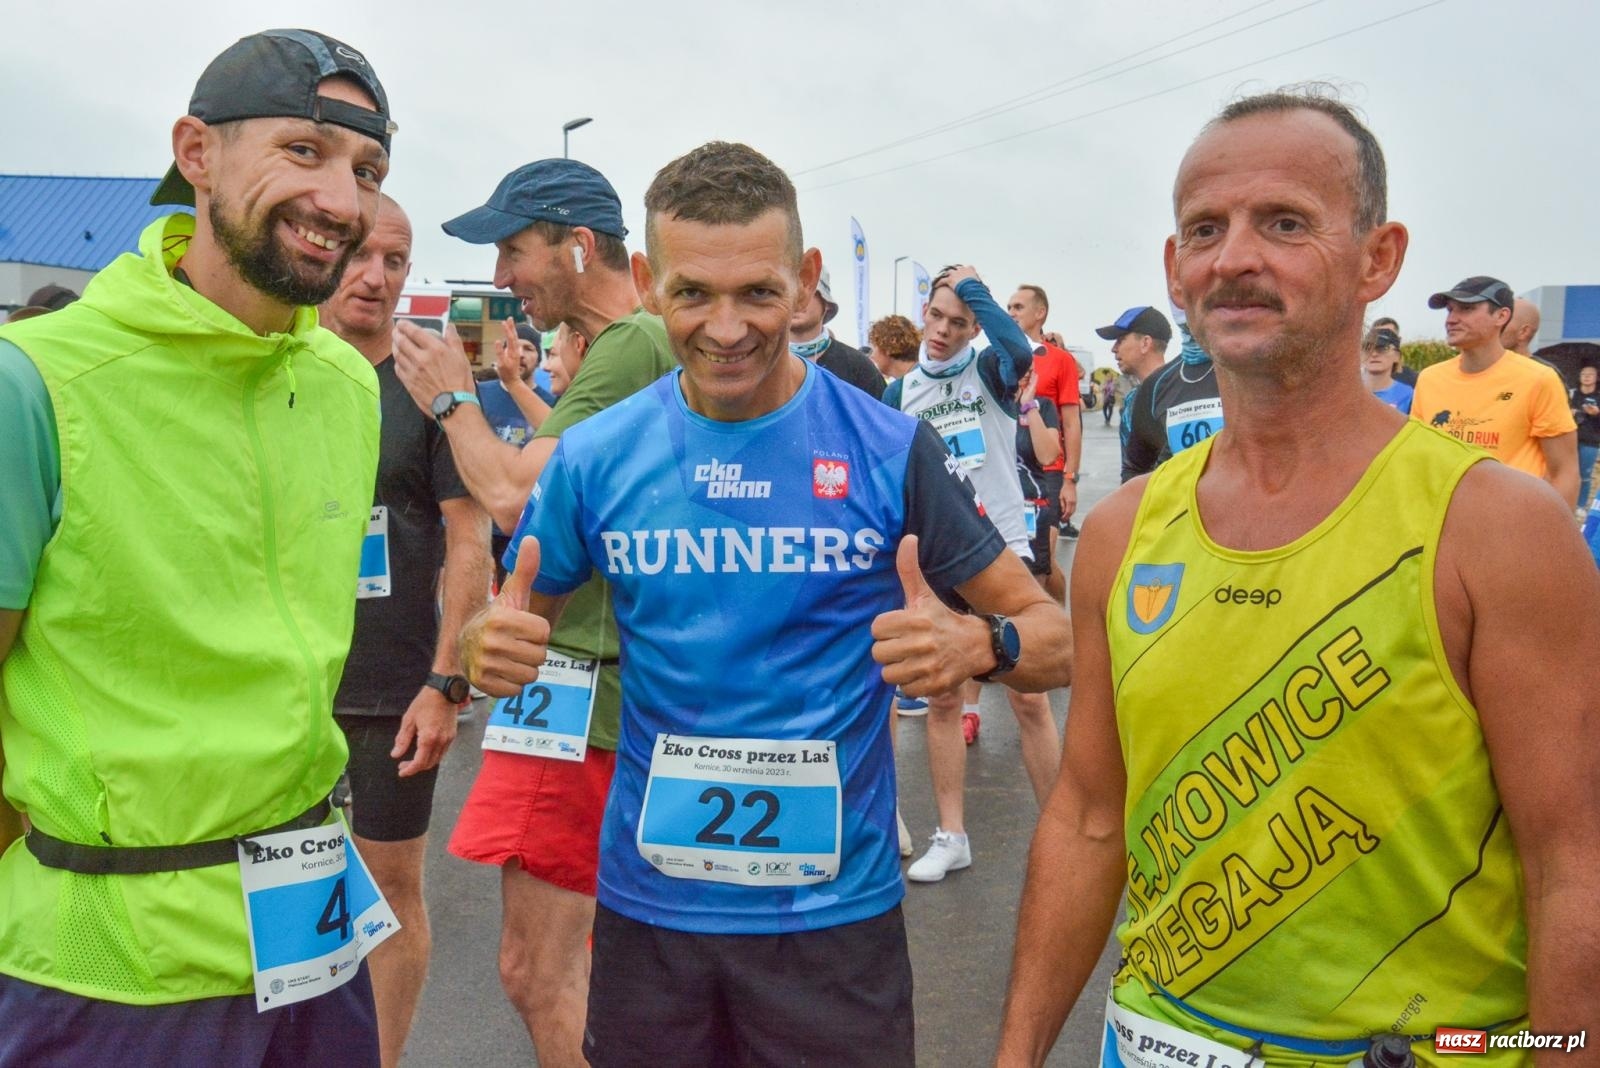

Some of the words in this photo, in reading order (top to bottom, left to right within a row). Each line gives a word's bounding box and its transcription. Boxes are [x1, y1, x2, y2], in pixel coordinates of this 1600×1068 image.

[1181, 421, 1212, 449] 60
[694, 458, 742, 482] eko
[813, 449, 849, 461] POLAND
[707, 481, 772, 498] okna
[601, 527, 884, 575] RUNNERS
[502, 685, 552, 728] 42
[662, 743, 693, 757] Eko
[698, 745, 742, 760] Cross
[747, 749, 796, 764] przez
[802, 749, 829, 763] Las
[694, 762, 721, 773] Kornice,
[722, 764, 732, 773] 30
[732, 766, 764, 775] września
[765, 768, 785, 776] 2023
[695, 787, 780, 848] 22
[251, 845, 294, 865] Eko
[300, 833, 344, 855] Cros
[301, 858, 335, 870] Kornice,
[1128, 786, 1380, 987] BIEGAJĄ
[1391, 993, 1427, 1032] energią
[1138, 1035, 1200, 1068] przez
